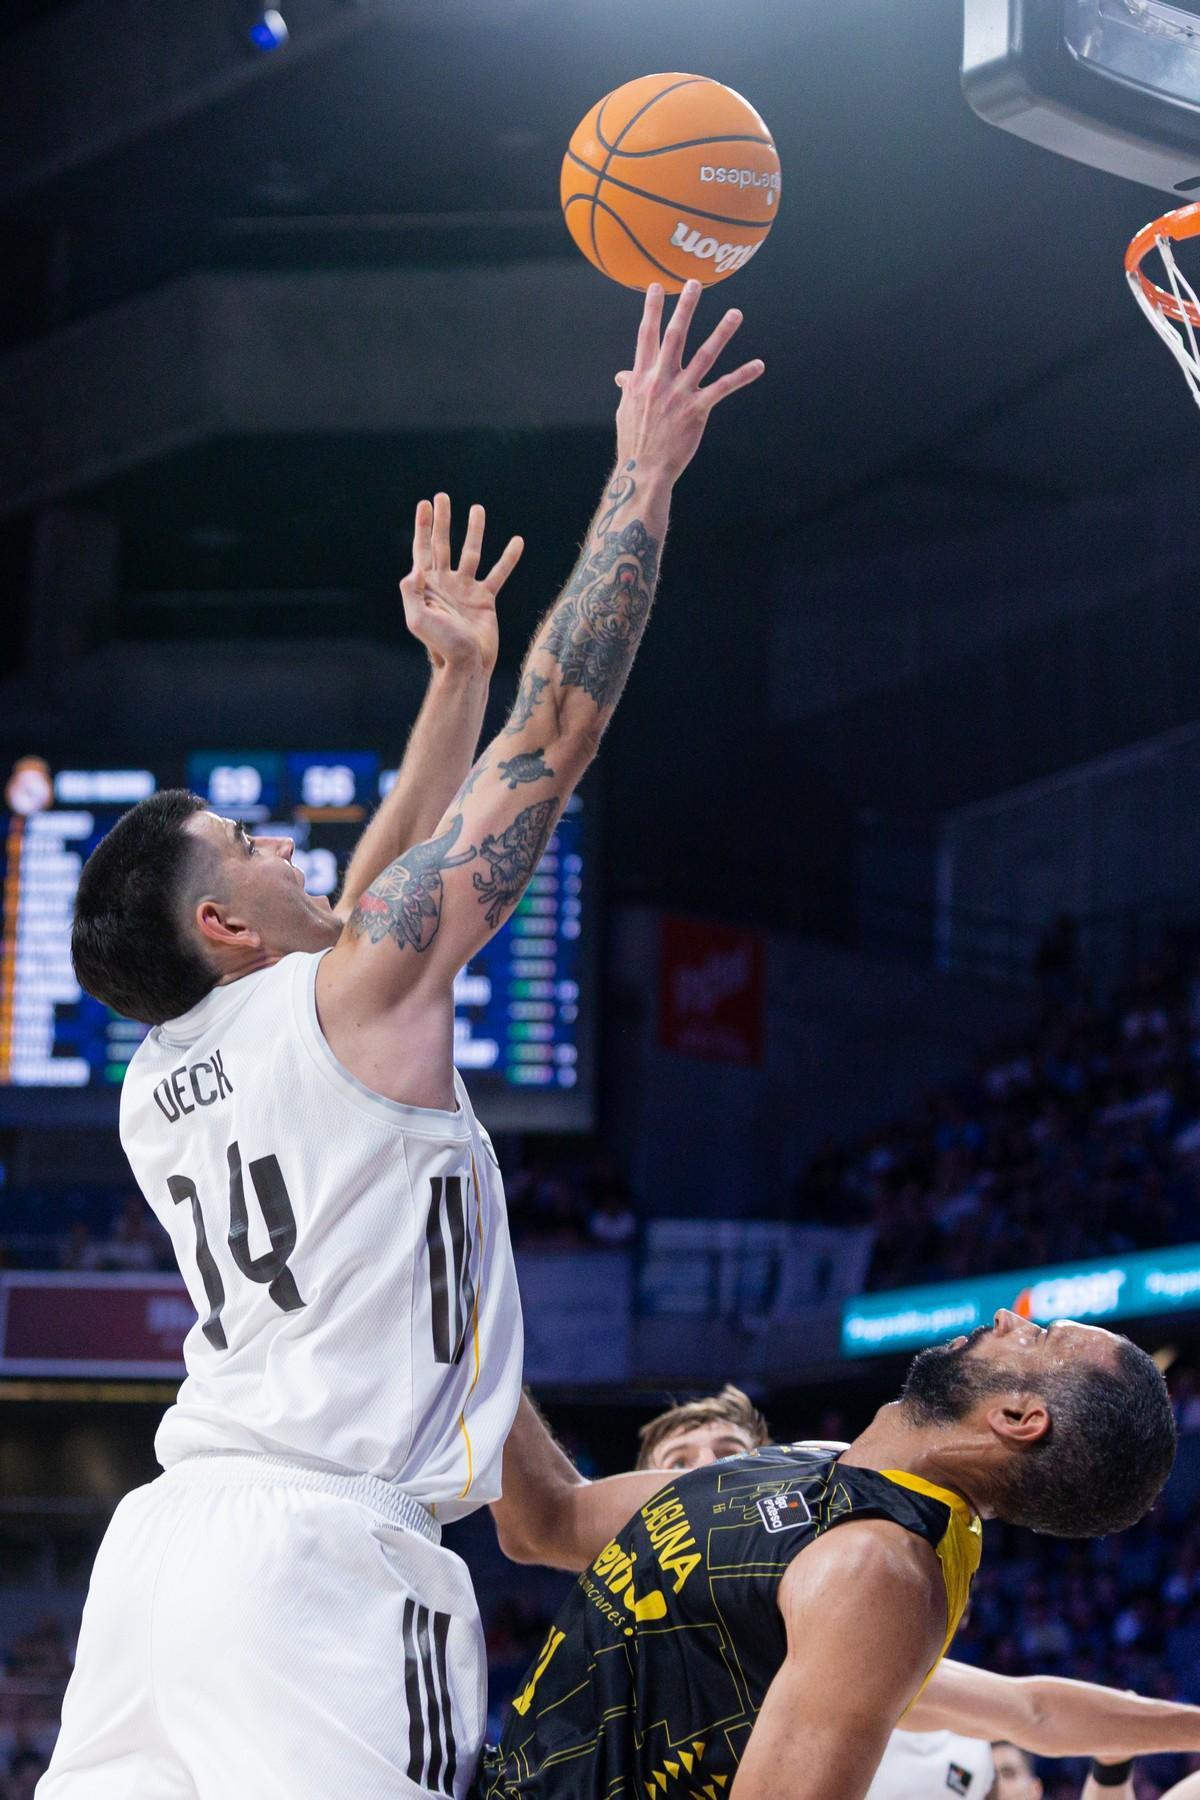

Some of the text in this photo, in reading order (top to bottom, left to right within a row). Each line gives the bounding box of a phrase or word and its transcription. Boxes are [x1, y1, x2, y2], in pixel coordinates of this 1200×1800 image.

[153, 1048, 233, 1124] DECK
[166, 1140, 308, 1351] 14
[641, 1486, 702, 1595] LAGUNA
